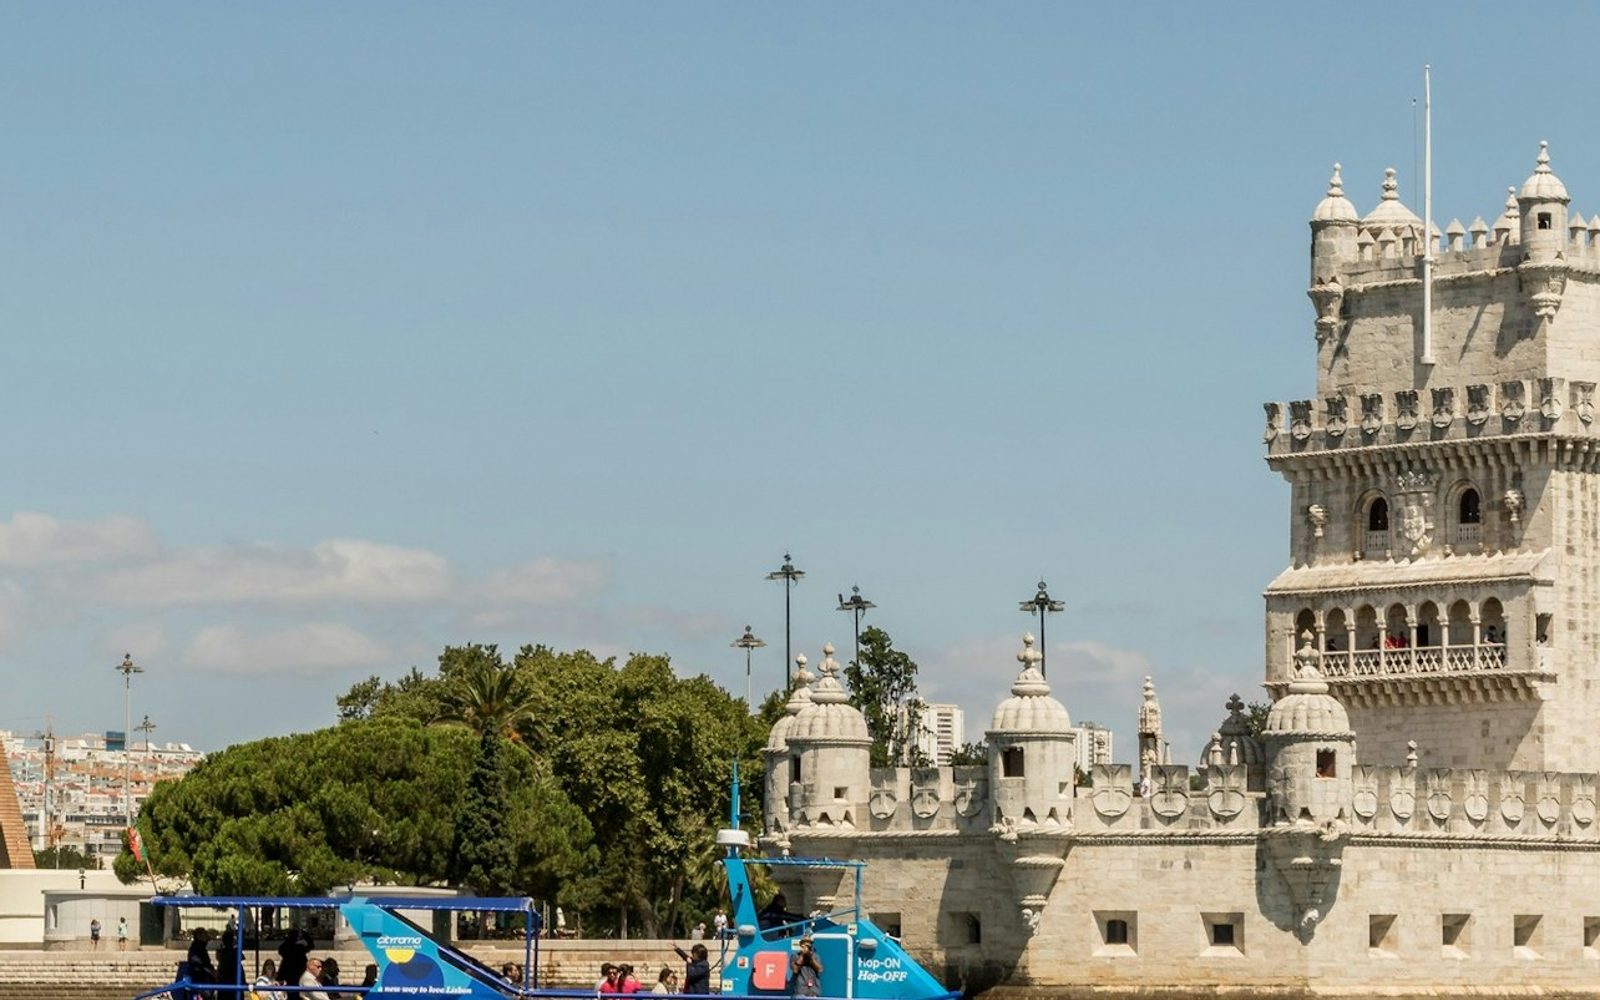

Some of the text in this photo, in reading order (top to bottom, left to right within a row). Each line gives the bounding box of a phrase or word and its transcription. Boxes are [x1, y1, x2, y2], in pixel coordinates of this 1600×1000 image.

[857, 956, 901, 970] Hop-ON
[765, 963, 776, 977] F
[857, 970, 908, 983] Hop-OFF
[402, 986, 419, 995] way
[428, 986, 444, 994] love
[446, 986, 472, 994] Lisbon
